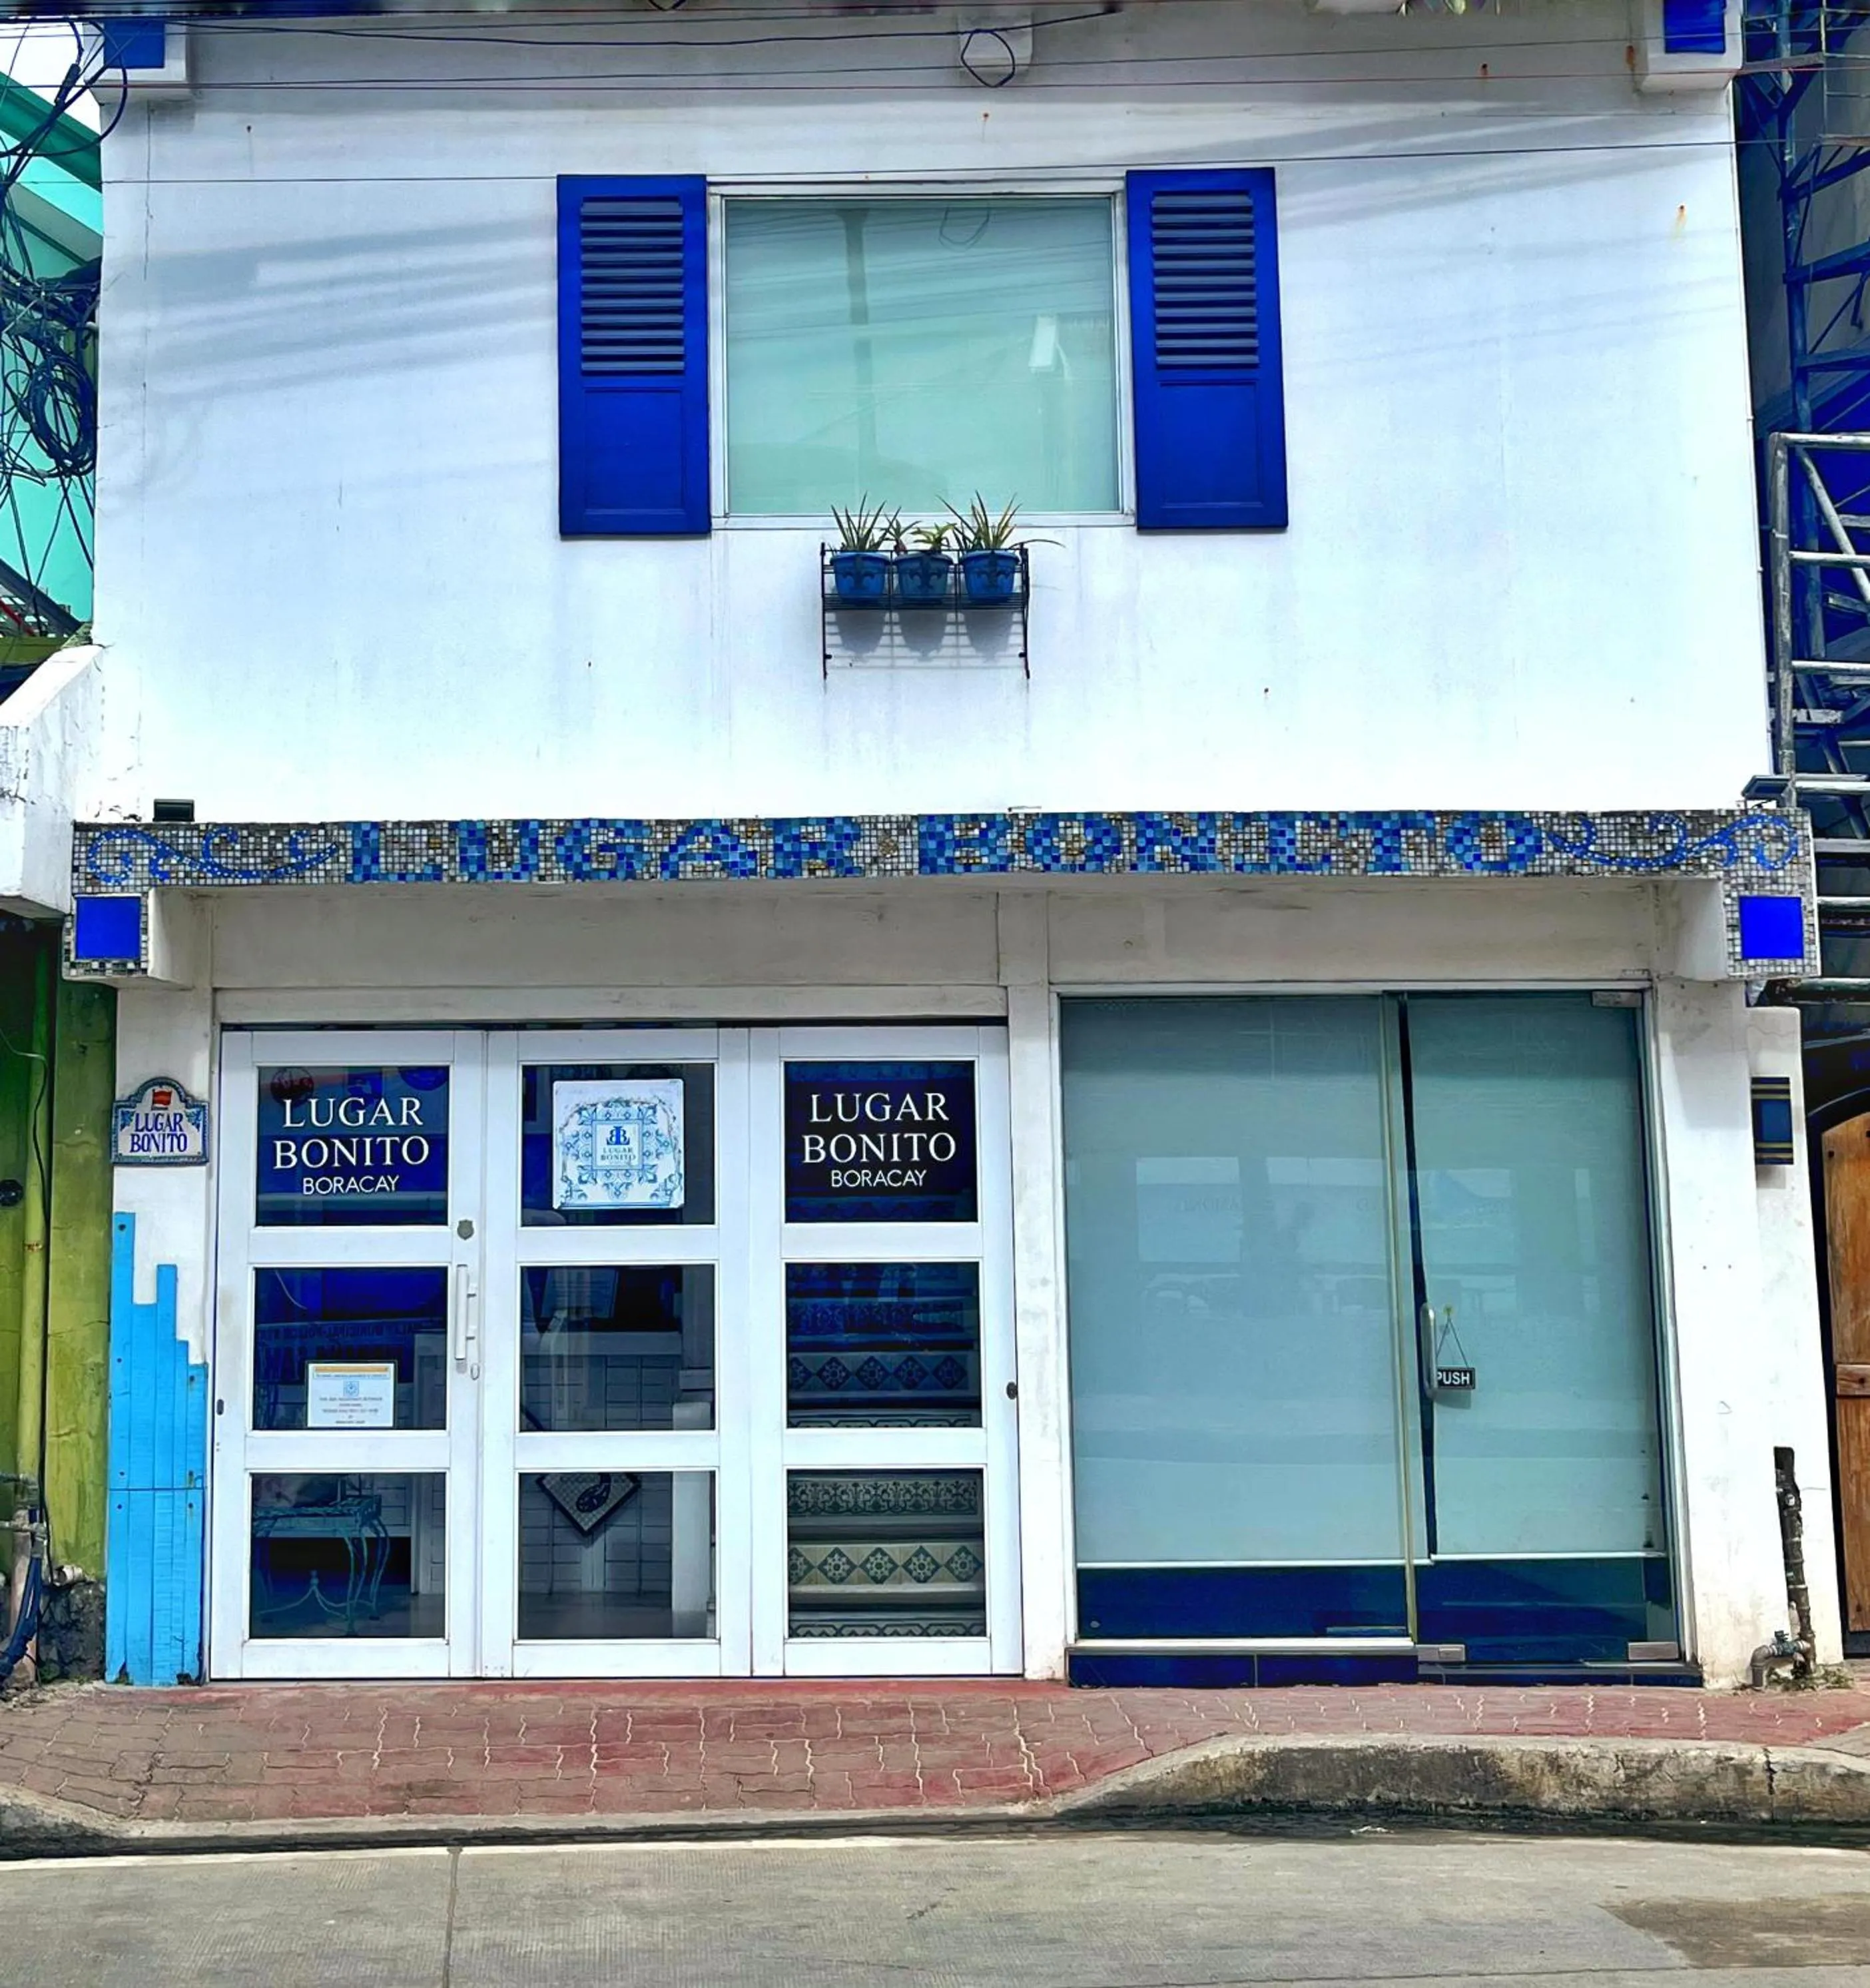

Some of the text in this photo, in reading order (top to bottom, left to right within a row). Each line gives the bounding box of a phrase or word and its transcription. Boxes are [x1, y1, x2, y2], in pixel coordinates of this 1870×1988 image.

[344, 811, 1543, 882] LUGAR BONITO
[135, 1112, 184, 1132] LUGAR
[284, 1097, 423, 1127] LUGAR
[810, 1092, 949, 1122] LUGAR
[130, 1133, 188, 1153] BONITO
[274, 1136, 429, 1169] BONITO
[802, 1132, 956, 1163] BONITO
[303, 1175, 399, 1195] BORACAY
[831, 1169, 926, 1188] BORACAY
